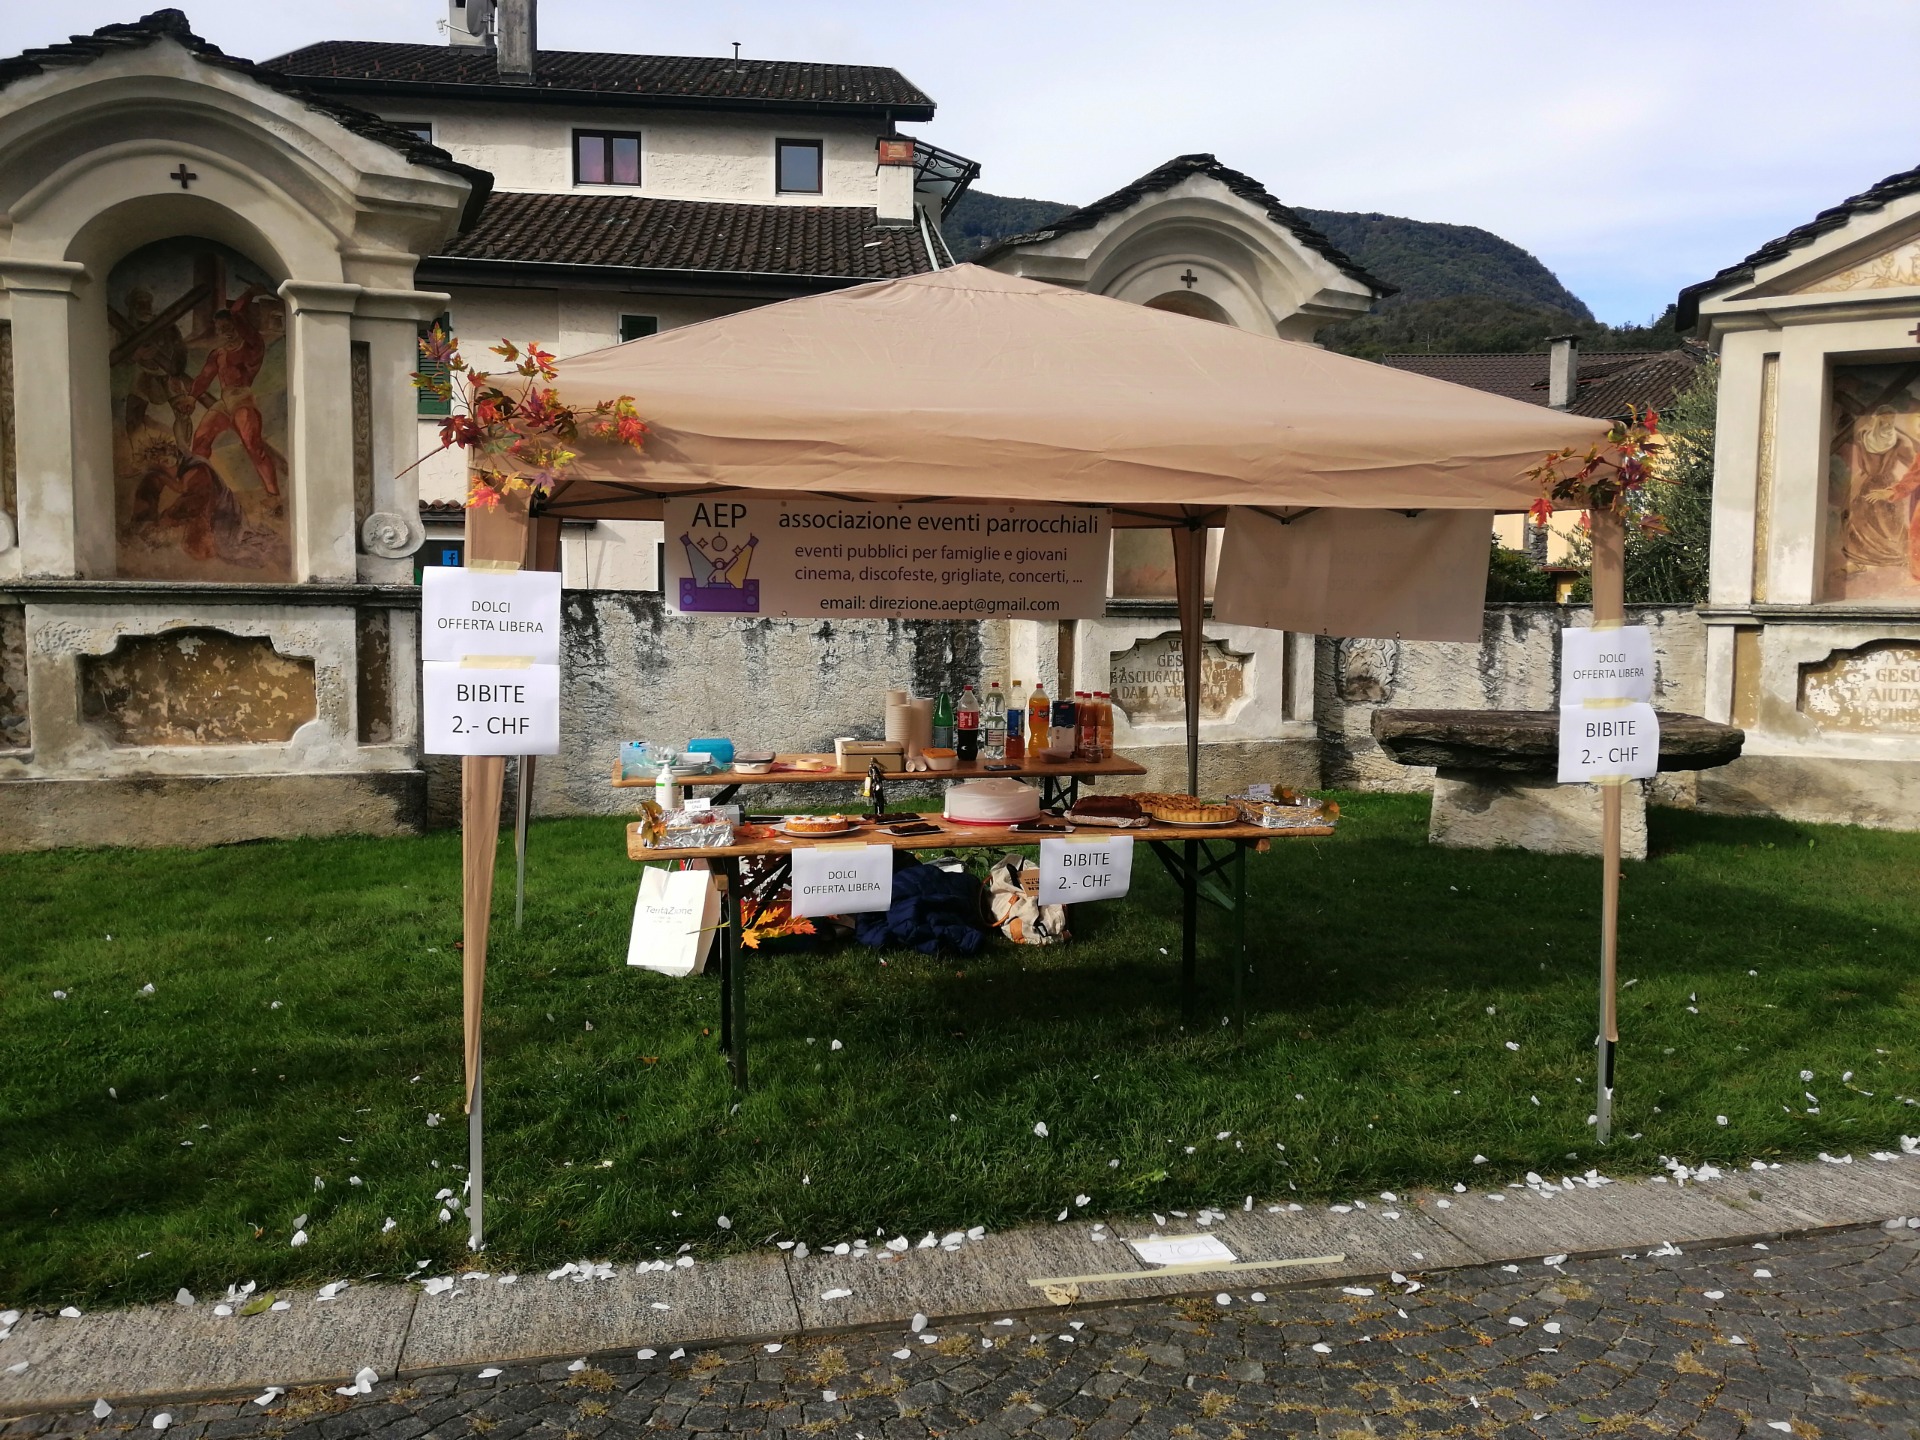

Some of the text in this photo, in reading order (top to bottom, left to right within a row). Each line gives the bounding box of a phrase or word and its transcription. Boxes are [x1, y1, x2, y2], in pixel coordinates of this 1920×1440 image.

[691, 502, 748, 529] AEP
[778, 509, 1098, 537] associazione eventi parrocchiali
[794, 544, 1068, 564] eventi pubblici per famiglie e giovani
[794, 566, 855, 583] cinema,
[858, 566, 938, 584] discofeste,
[941, 568, 1005, 586] grigliate,
[1008, 570, 1069, 585] concerti,
[471, 600, 511, 613] DOLCI
[819, 596, 1060, 614] email: direzione.aept@gmail.com
[437, 617, 544, 634] OFFERTA LIBERA
[1157, 653, 1184, 668] GES
[1599, 653, 1626, 664] DOLCI
[1572, 667, 1645, 680] OFFERTA LIBERA
[457, 683, 525, 704] BIBITE
[1866, 688, 1920, 702] AIUTA
[451, 715, 530, 735] 2.- CHF
[1586, 720, 1637, 738] BIBITE
[1581, 746, 1639, 765] 2.- CHF
[1063, 852, 1111, 867] BIBITE
[828, 870, 857, 880] DOLCI
[1058, 873, 1112, 890] 2.- CHF
[803, 882, 881, 895] OFFERTA LIBERA
